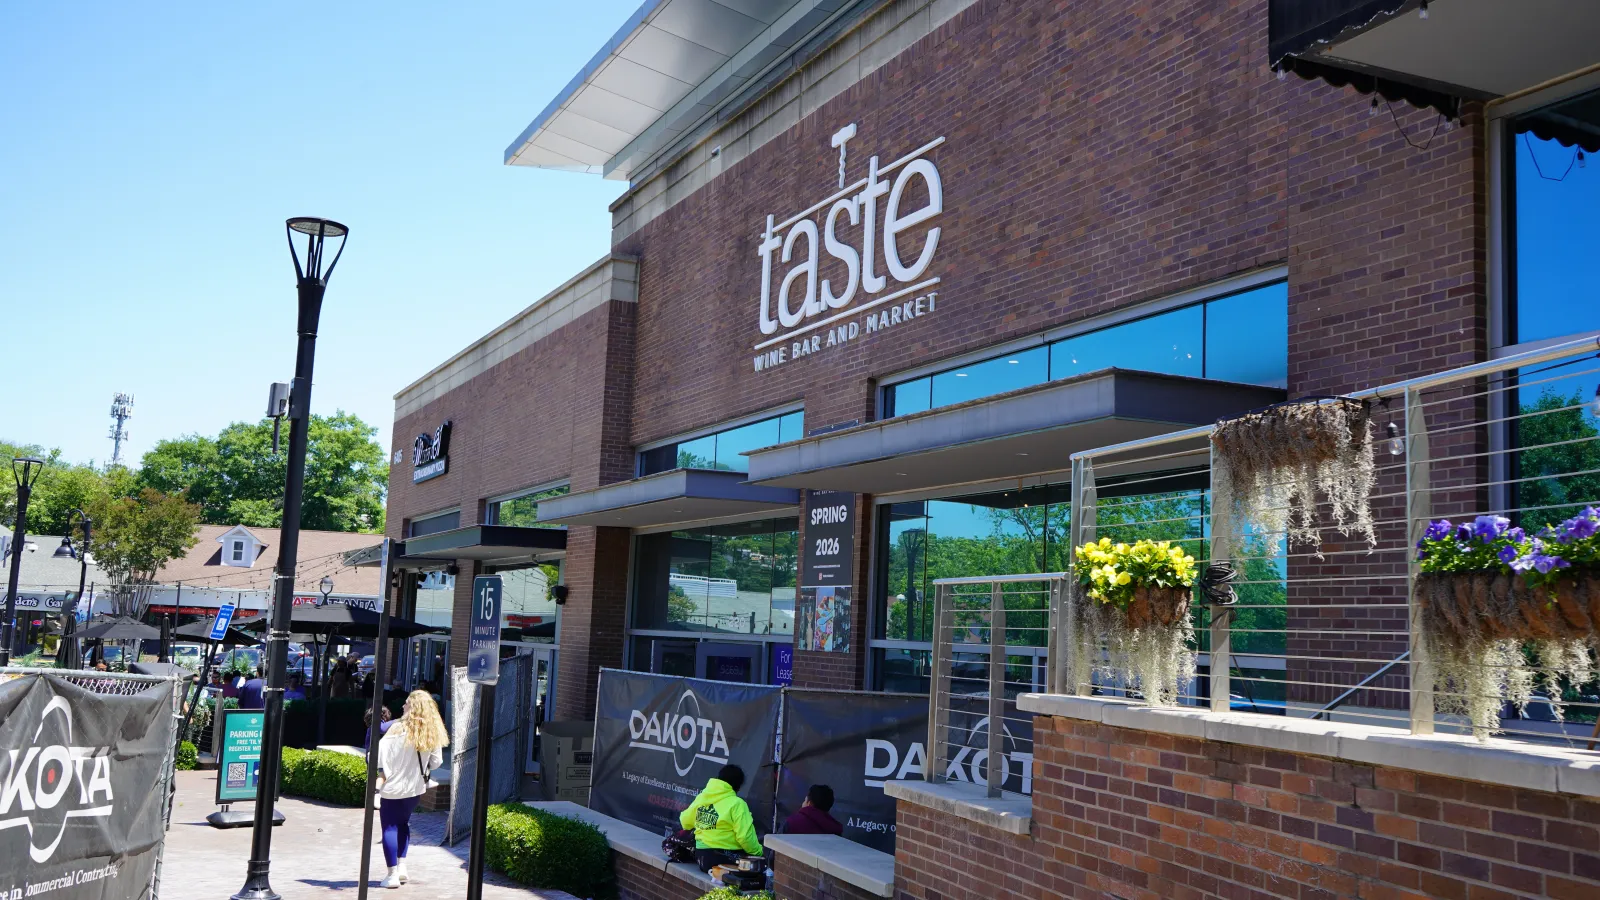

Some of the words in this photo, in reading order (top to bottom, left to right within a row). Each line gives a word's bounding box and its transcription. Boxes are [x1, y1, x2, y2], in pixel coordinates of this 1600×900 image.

[758, 155, 943, 334] taste
[753, 346, 786, 372] WINE
[792, 335, 821, 359] BAR
[827, 321, 859, 346] AND
[866, 292, 939, 333] MARKET
[811, 505, 847, 526] SPRING
[815, 537, 839, 556] 2026
[480, 587, 494, 620] 15
[474, 626, 496, 635] MINUTE
[472, 639, 496, 649] PARKING
[780, 650, 790, 664] For
[776, 665, 792, 680] Lease
[229, 730, 258, 738] PARKING
[629, 709, 730, 756] DAKOTA
[864, 739, 1033, 794] DAKOT
[0, 744, 113, 815] KOTA
[626, 772, 640, 784] Legacy
[645, 776, 666, 789] Excellence
[666, 781, 671, 790] in
[671, 783, 699, 797] Commercial
[847, 816, 854, 827] A
[856, 817, 887, 834] Legacy
[10, 885, 23, 900] in
